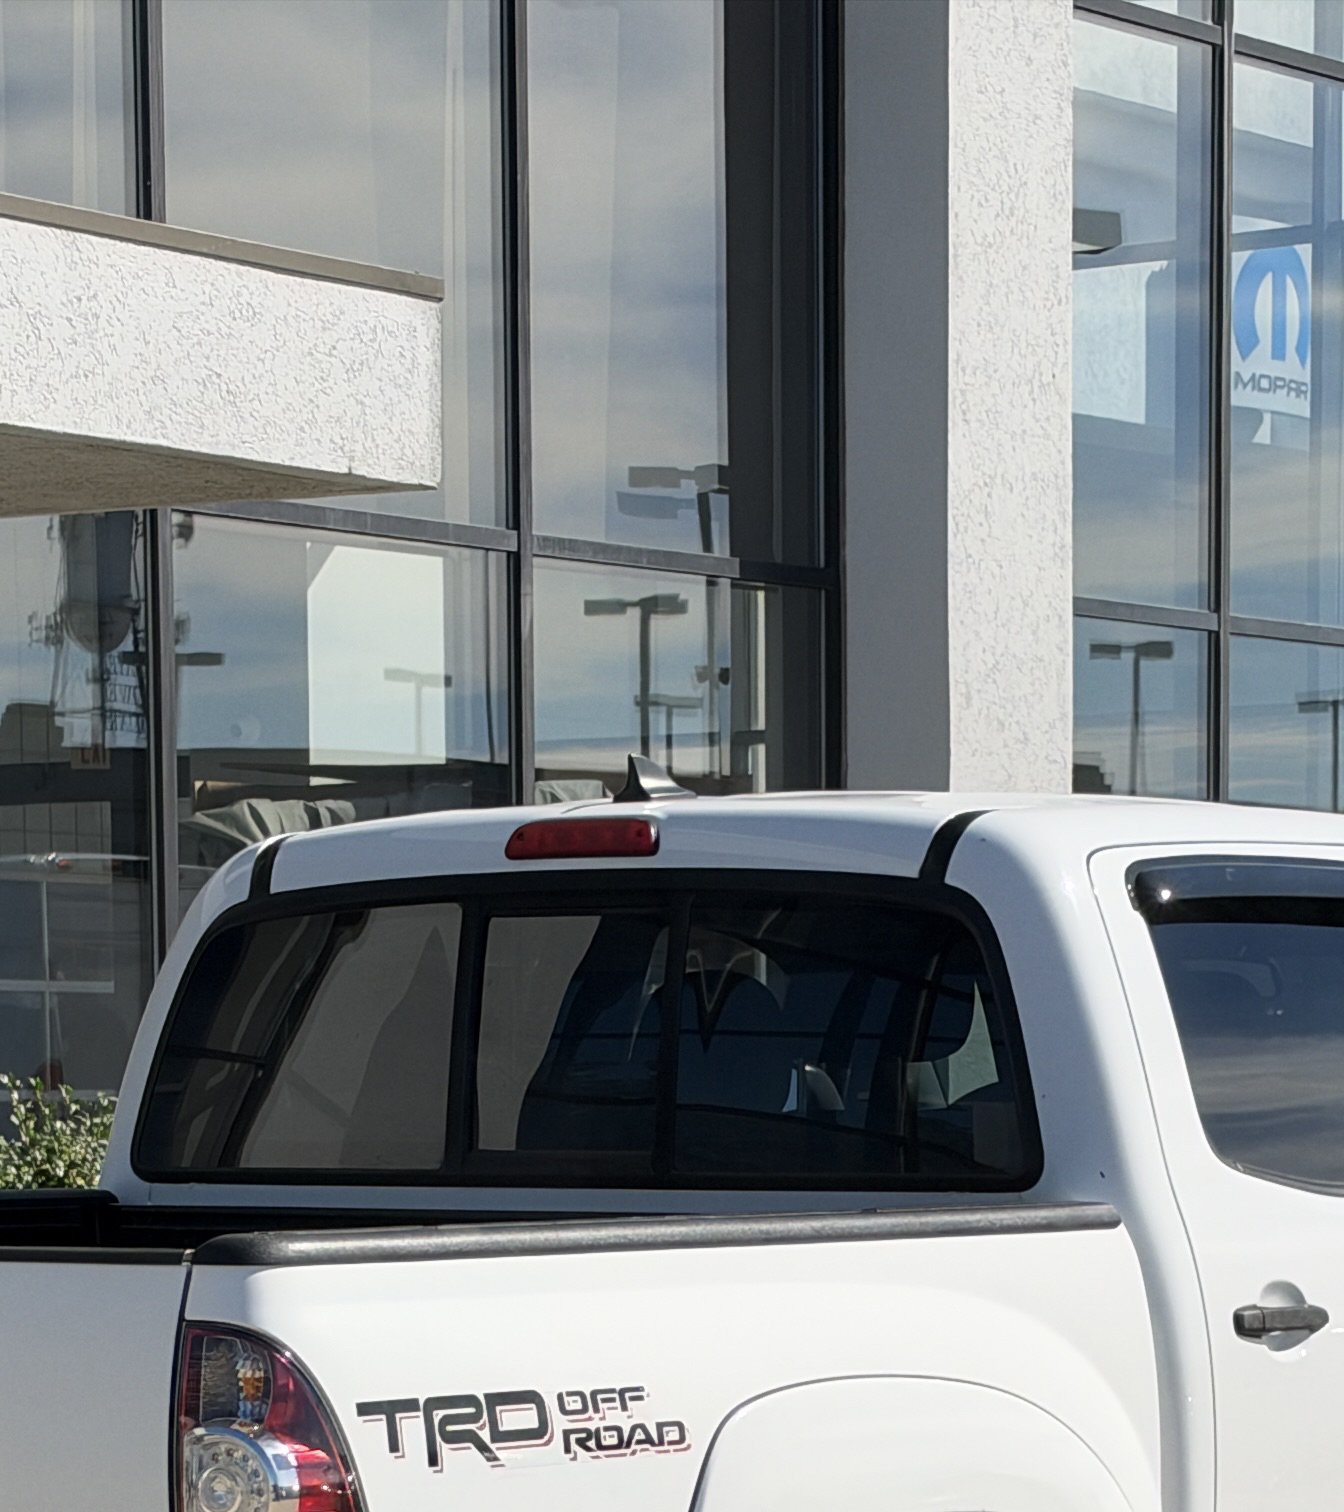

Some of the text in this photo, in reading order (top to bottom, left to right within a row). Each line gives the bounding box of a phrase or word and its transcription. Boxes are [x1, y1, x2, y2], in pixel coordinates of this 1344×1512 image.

[1233, 370, 1309, 402] MOPAR
[556, 1385, 650, 1423] OFF
[355, 1389, 554, 1474] TRD
[561, 1419, 692, 1462] ROAD
